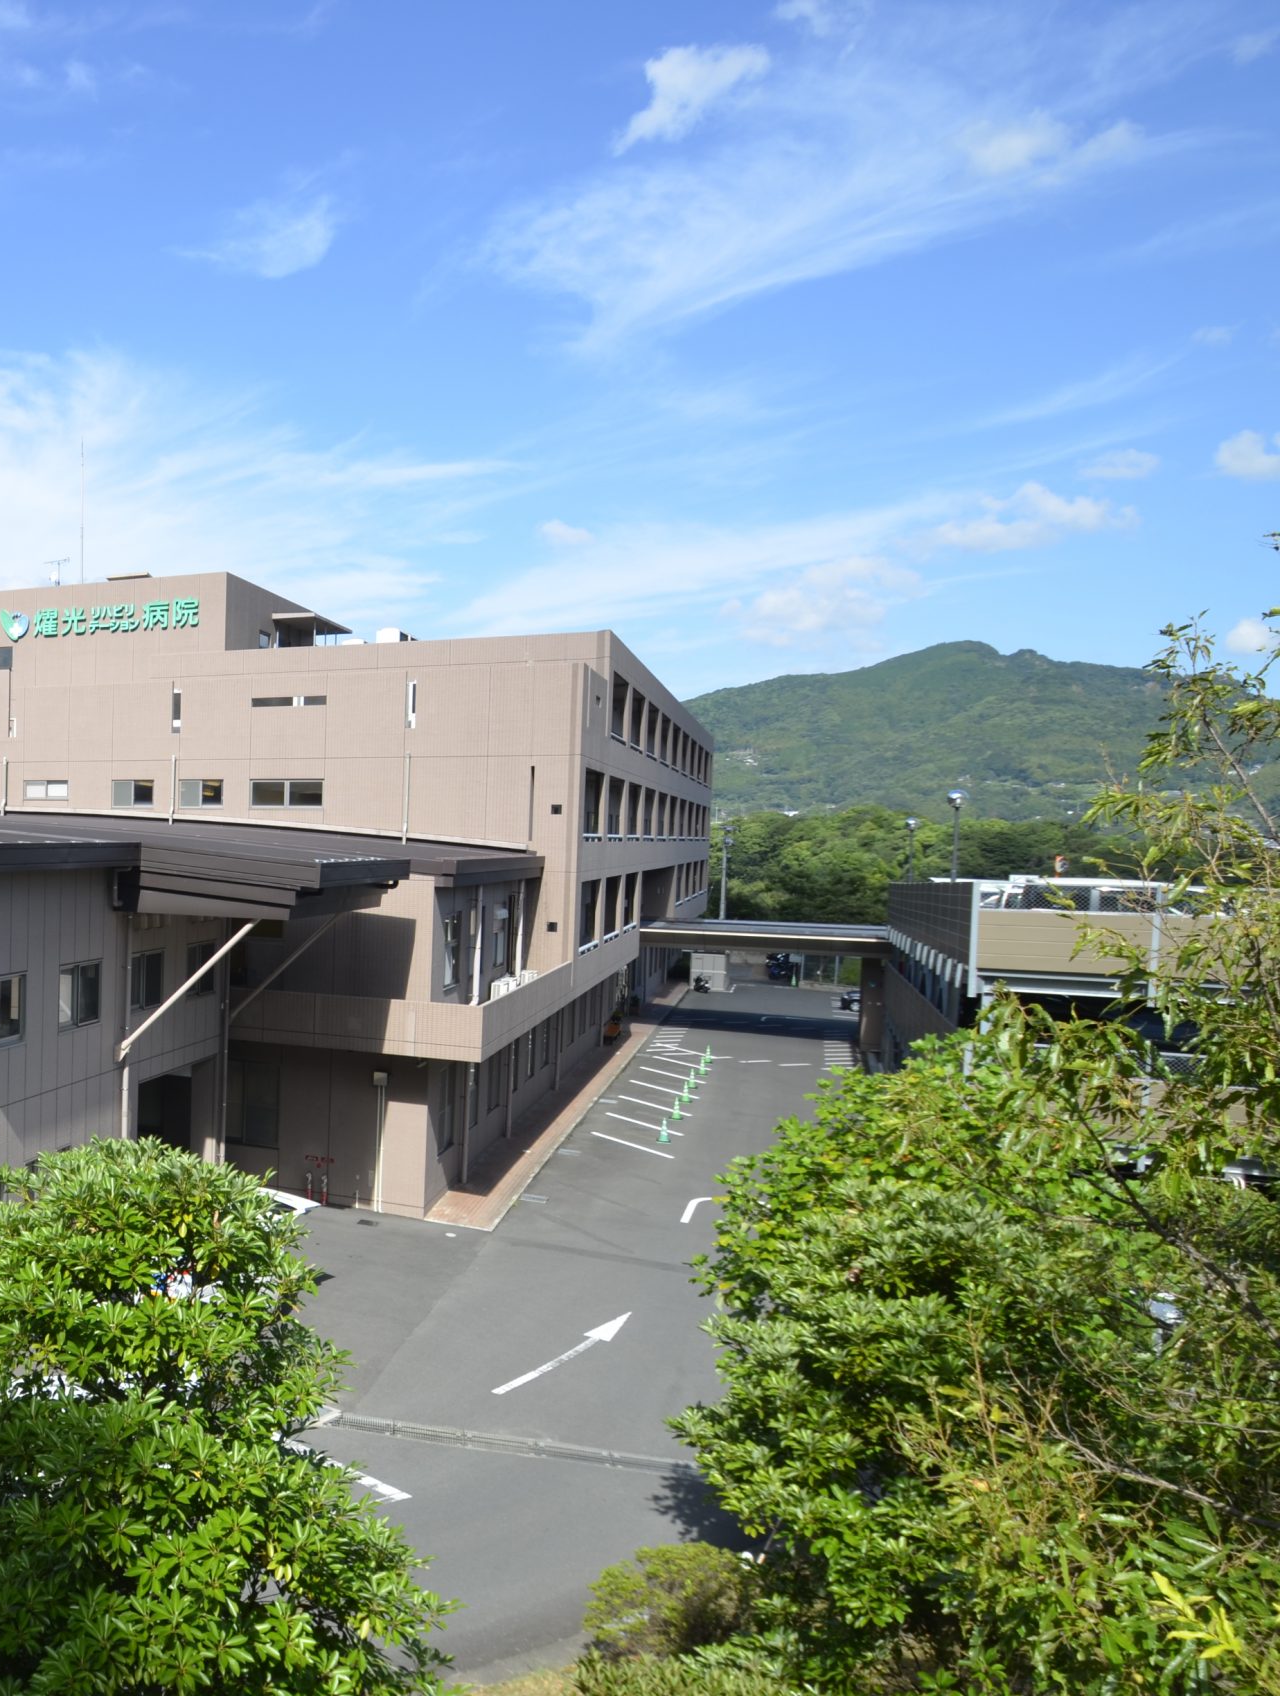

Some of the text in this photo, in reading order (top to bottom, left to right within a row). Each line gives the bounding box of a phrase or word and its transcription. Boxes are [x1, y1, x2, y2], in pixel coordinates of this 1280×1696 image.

[91, 604, 135, 620] リハビリ
[143, 598, 199, 631] 病院
[89, 619, 140, 635] テーション
